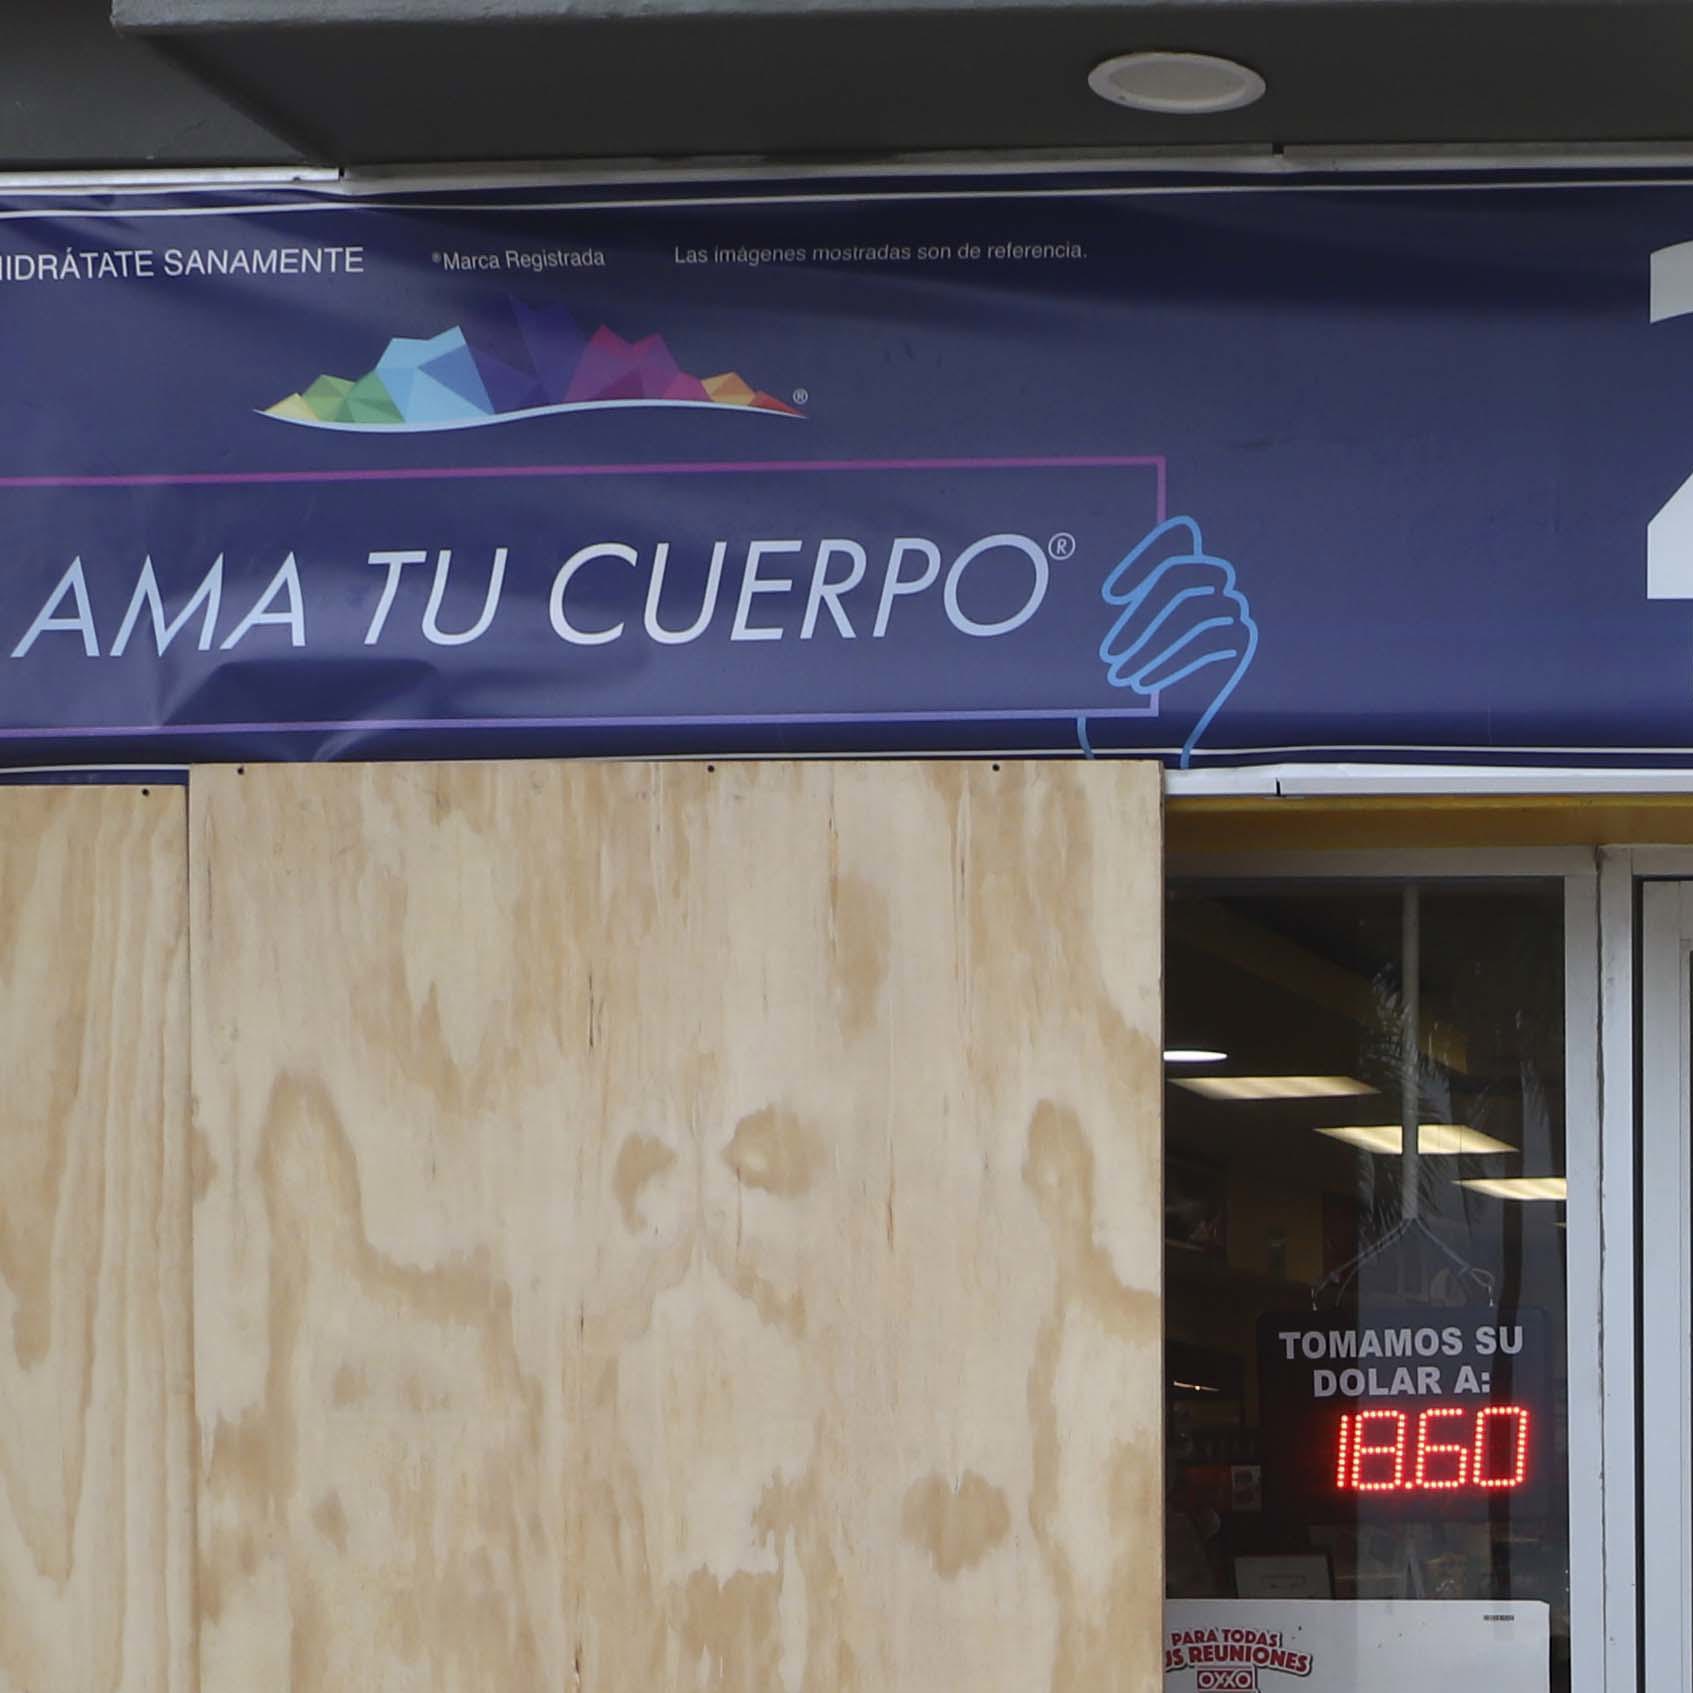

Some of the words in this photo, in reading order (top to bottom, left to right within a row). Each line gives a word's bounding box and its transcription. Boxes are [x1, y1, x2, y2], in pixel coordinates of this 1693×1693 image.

[0, 246, 154, 280] IDRÁTATE
[163, 246, 364, 277] SANAMENTE
[506, 248, 606, 273] Registrada
[674, 246, 708, 264] Las
[714, 245, 806, 267] imágenes
[812, 244, 911, 262] mostradas
[917, 244, 951, 260] son
[957, 242, 981, 260] de
[987, 240, 1088, 260] referencia.
[10, 554, 306, 659] AMA
[364, 547, 508, 645] TU
[1278, 1328, 1463, 1360] TOMAMOS
[1475, 1326, 1523, 1354] SU
[1313, 1366, 1442, 1397] DOLAR
[1454, 1366, 1491, 1394] A:
[1171, 1630, 1219, 1647] PARA
[1224, 1628, 1278, 1648] TODAS
[1188, 1645, 1309, 1673] REUNIONES
[1199, 1671, 1252, 1688] OXXO
